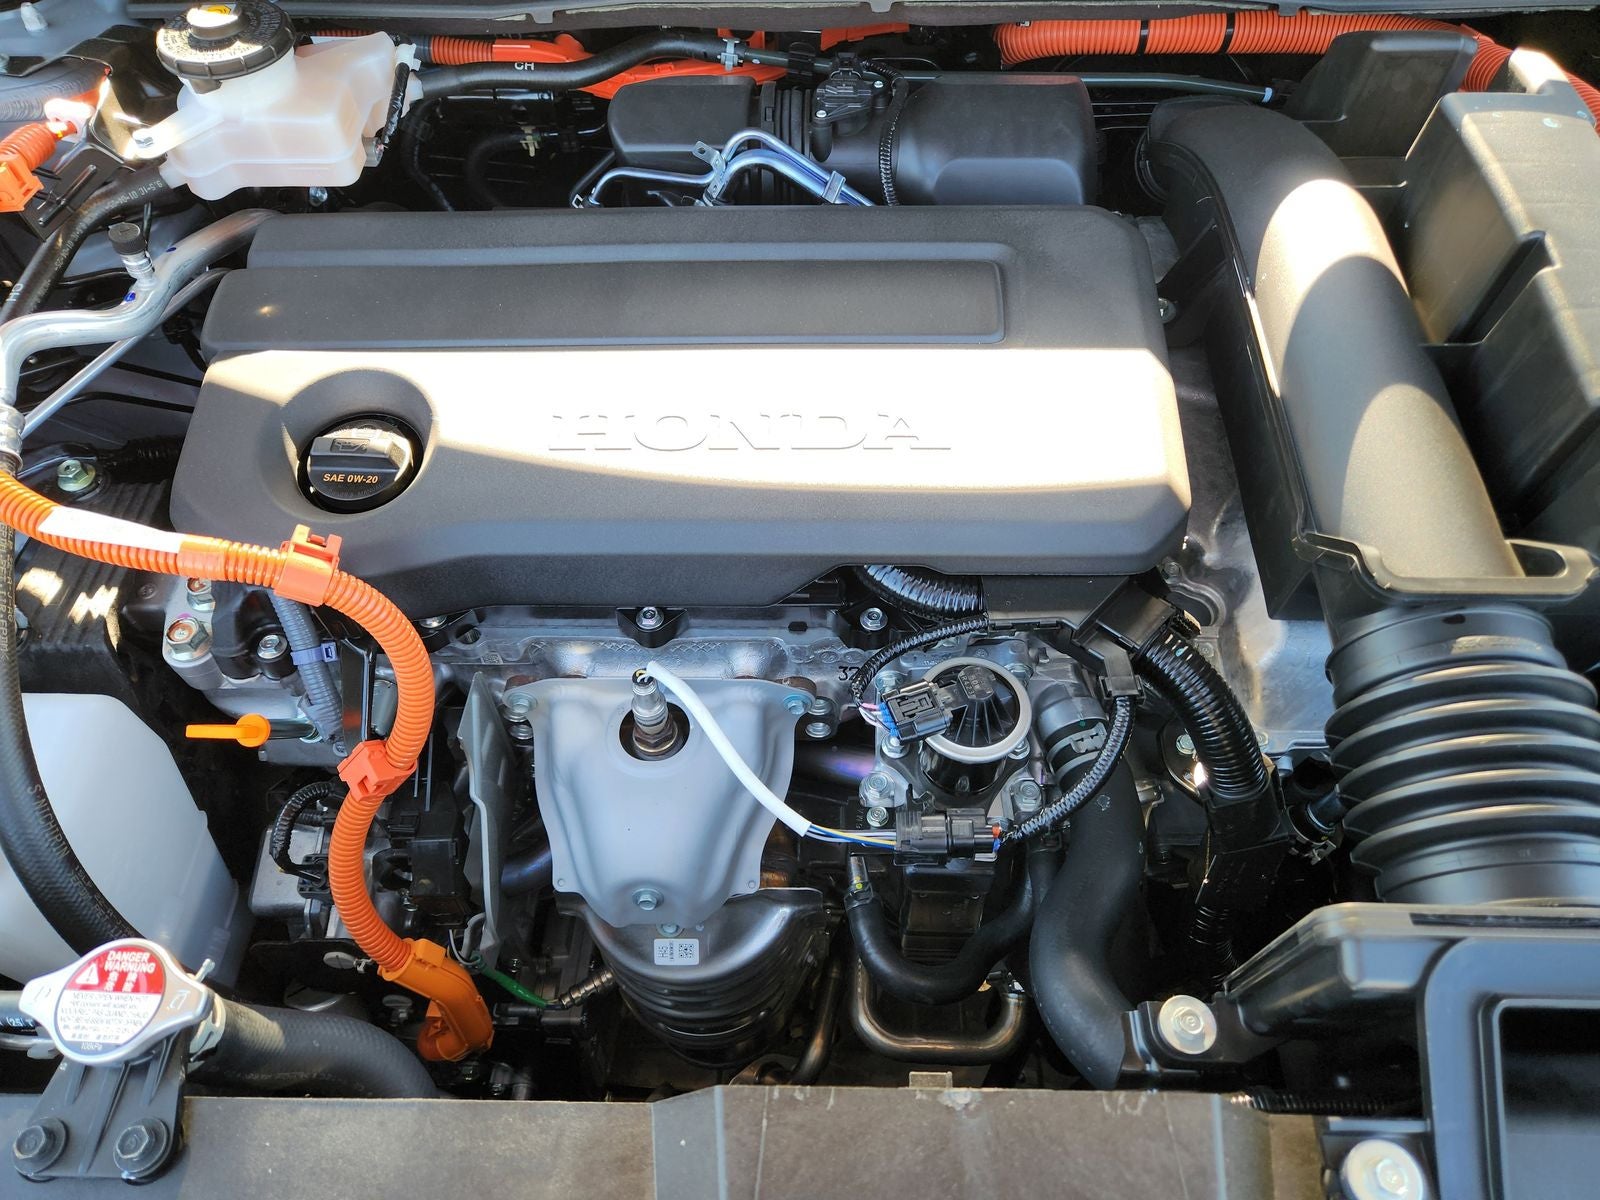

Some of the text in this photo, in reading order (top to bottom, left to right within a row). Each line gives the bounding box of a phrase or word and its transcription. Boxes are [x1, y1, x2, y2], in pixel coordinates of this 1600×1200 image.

[514, 61, 535, 71] CH
[549, 413, 951, 452] HONDA
[322, 473, 378, 484] SAE 0W-20
[106, 950, 151, 963] DANGER
[103, 960, 156, 974] WARNUNG
